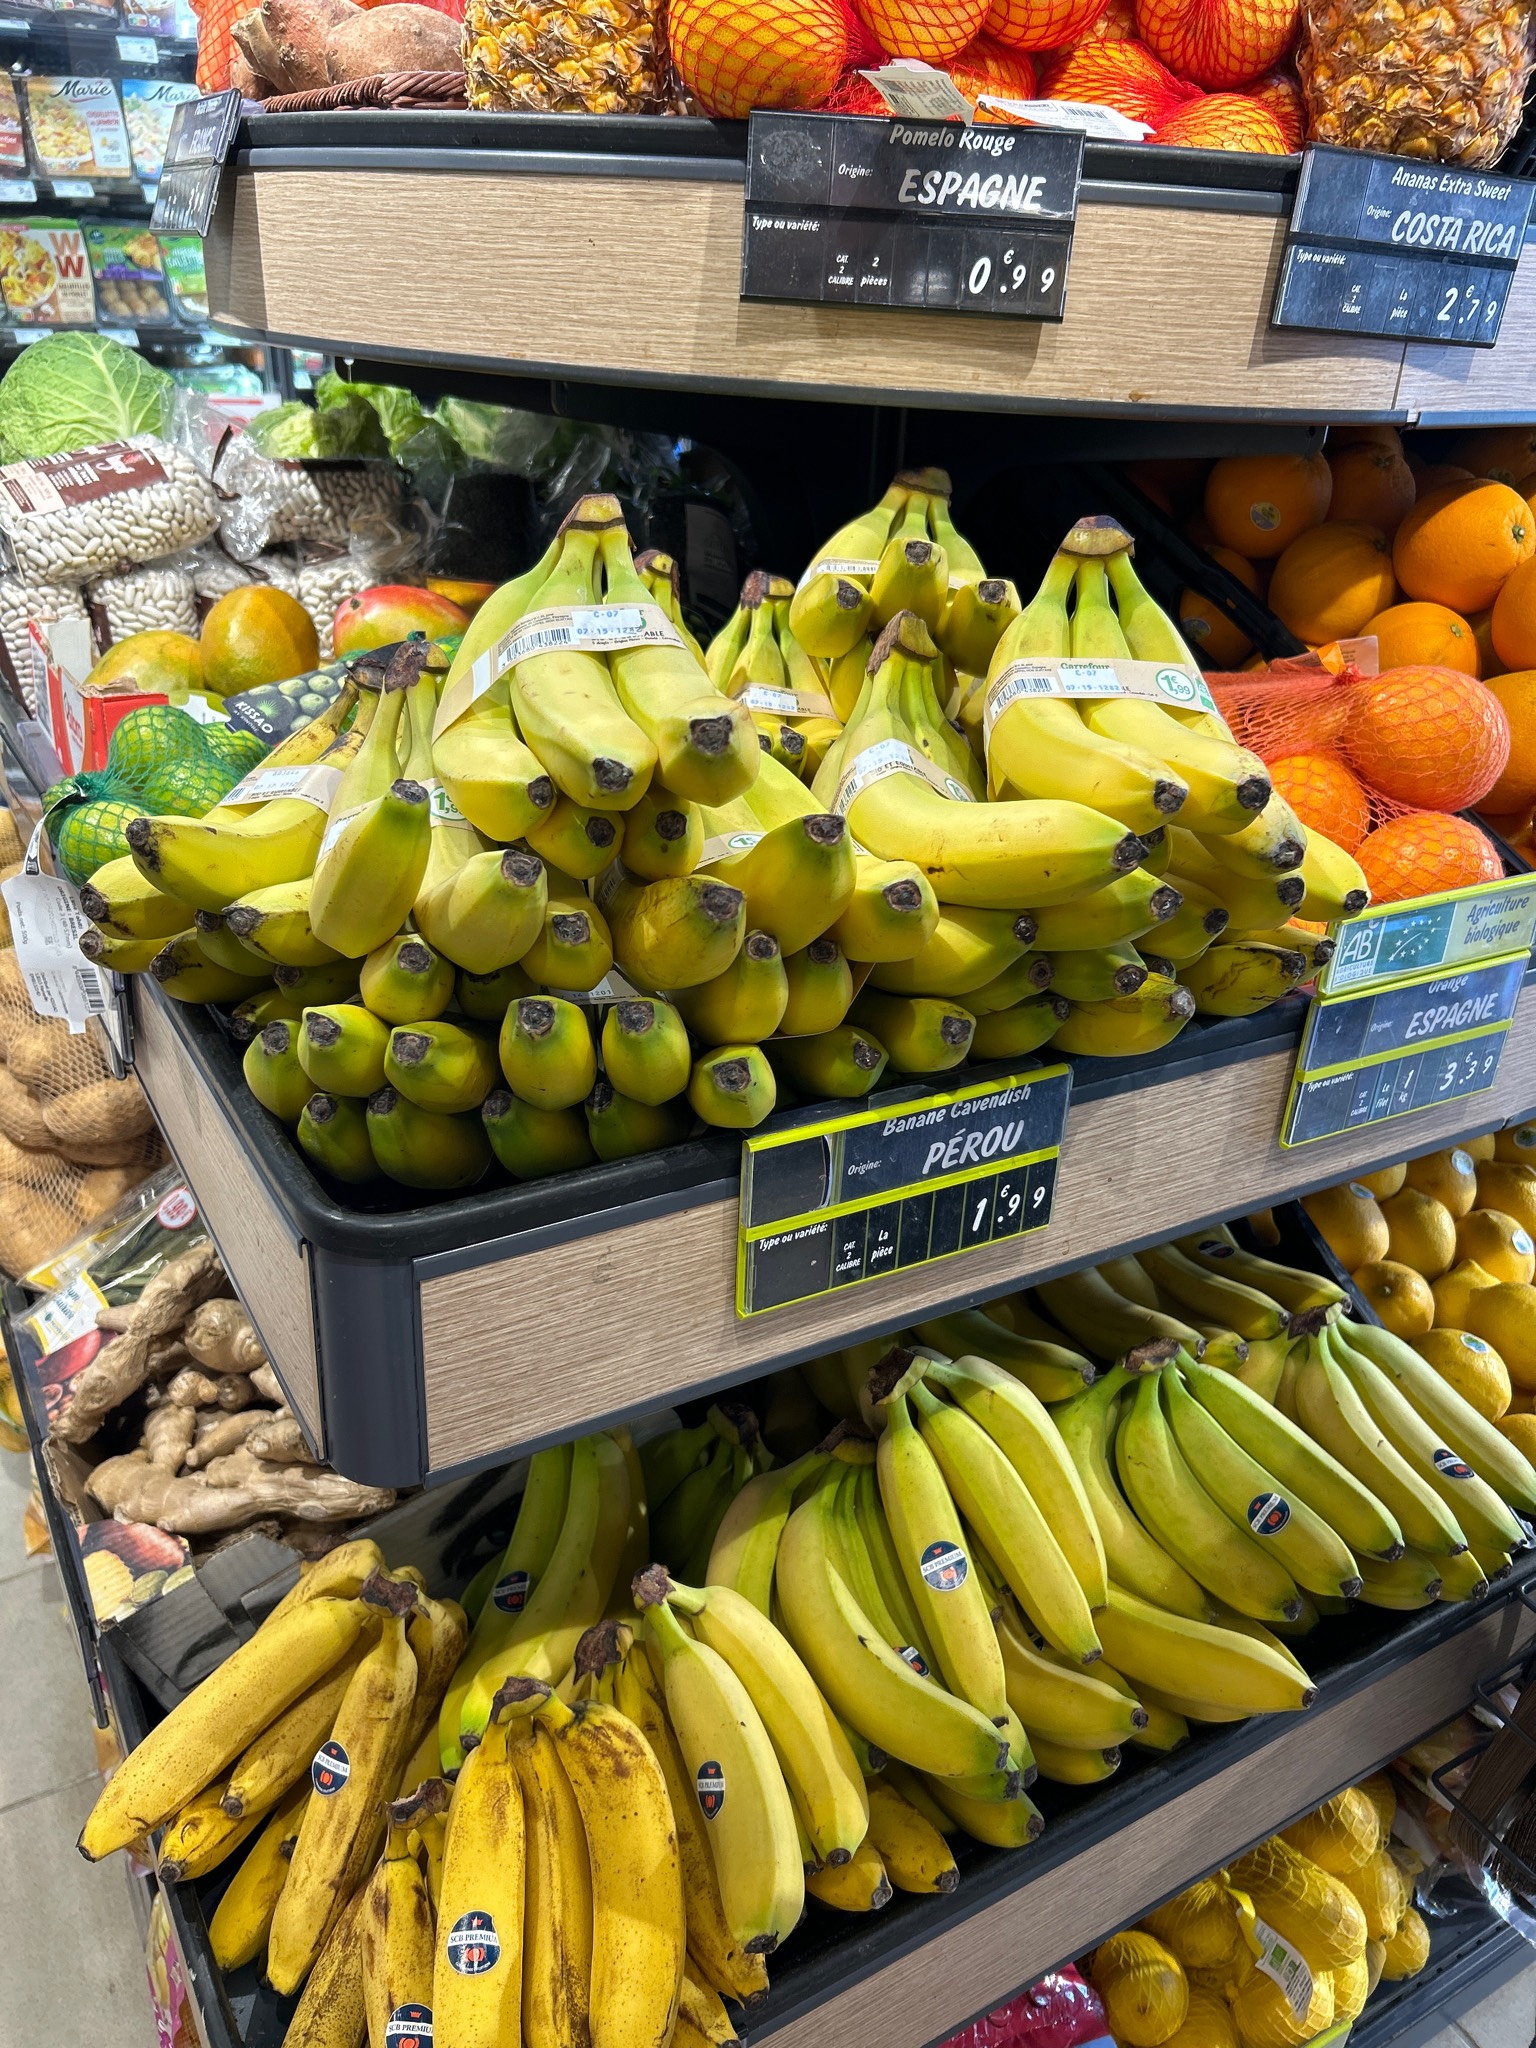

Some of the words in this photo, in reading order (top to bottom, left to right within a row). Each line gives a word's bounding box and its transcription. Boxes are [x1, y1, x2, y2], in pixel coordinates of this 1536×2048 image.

[50, 78, 111, 98] Marie
[144, 85, 199, 102] Marie
[890, 124, 954, 147] Pomelo
[959, 130, 1015, 156] Rouge
[838, 164, 873, 178] Origine:
[898, 169, 1046, 210] ESPAGNE
[1392, 166, 1438, 190] Ananas
[1439, 174, 1473, 196] Extra
[1474, 180, 1512, 201] Sweet
[1367, 205, 1391, 218] Origine:
[752, 216, 772, 229] Type
[774, 219, 785, 229] ou
[787, 219, 820, 232] variété:
[1392, 211, 1463, 250] COSTA
[1463, 220, 1516, 256] RICA
[872, 257, 880, 267] 2
[1296, 250, 1312, 262] Type
[1313, 254, 1321, 262] ou
[1322, 254, 1346, 265] variété:
[839, 266, 844, 274] 2
[828, 276, 854, 286] CALIBRE
[860, 275, 888, 287] pièces
[1400, 289, 1408, 301] La
[1390, 306, 1408, 320] pièce
[235, 701, 273, 733] KISSAO
[57, 886, 71, 912] ORIGINE
[1467, 895, 1530, 924] Agriculture
[1464, 920, 1520, 945] biologique
[1341, 930, 1373, 964] AB
[1429, 976, 1468, 995] Orange
[1405, 993, 1498, 1039] ESPAGNE
[1308, 1079, 1321, 1091] Type
[1321, 1078, 1329, 1087] ou
[1330, 1072, 1353, 1086] variété:
[1382, 1083, 1390, 1093] Le
[1404, 1070, 1413, 1089] 1
[1376, 1098, 1389, 1109] Filet
[1399, 1091, 1407, 1103] kg
[883, 1109, 946, 1136] Banane
[951, 1084, 1031, 1119] Cavendish
[922, 1121, 1024, 1174] PÉROU
[848, 1160, 882, 1176] Origine:
[759, 1238, 780, 1251] Type
[782, 1233, 793, 1243] ou
[794, 1223, 828, 1240] variété:
[878, 1230, 888, 1242] La
[871, 1244, 893, 1263] pièce
[835, 1257, 861, 1272] CALIBRE
[934, 1551, 962, 1568] PREMIUM
[450, 1933, 464, 1943] SCB
[388, 2023, 401, 2032] SCB
[402, 2024, 433, 2033] PREMIU
